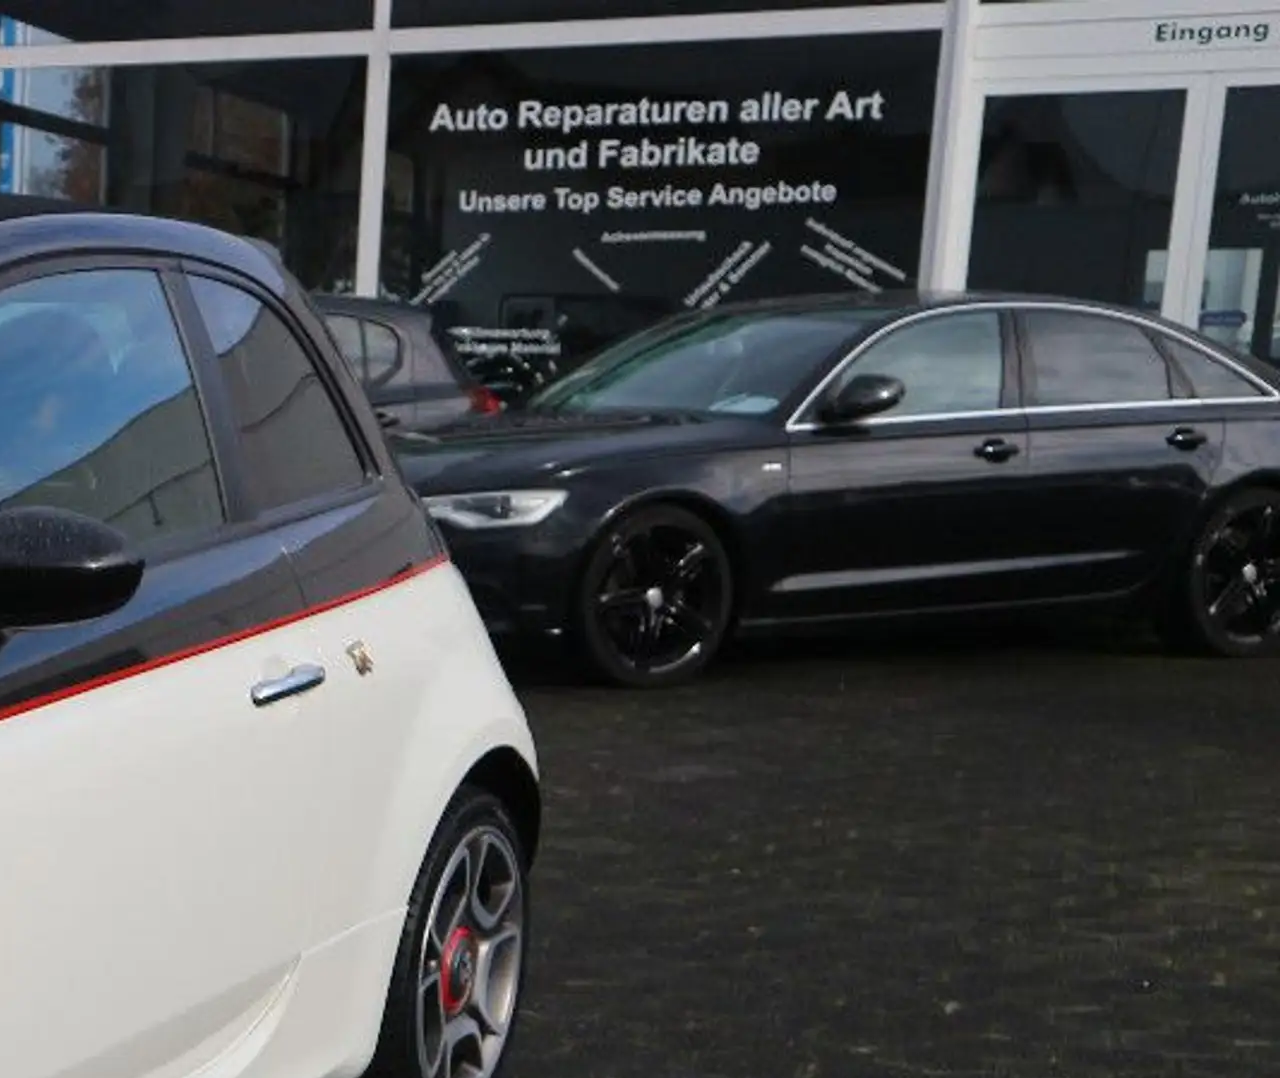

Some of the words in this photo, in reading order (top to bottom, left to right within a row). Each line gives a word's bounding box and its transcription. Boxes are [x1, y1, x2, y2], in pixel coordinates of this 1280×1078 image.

[1154, 22, 1270, 45] Eingang
[429, 103, 509, 132] Auto
[517, 98, 729, 134] Reparaturen
[739, 93, 819, 123] aller
[823, 90, 885, 121] Art
[523, 141, 589, 171] und
[598, 137, 761, 168] Fabrikate
[458, 190, 546, 214] Unsere
[553, 187, 600, 214] Top
[606, 184, 704, 210] Service
[706, 181, 838, 209] Angebote
